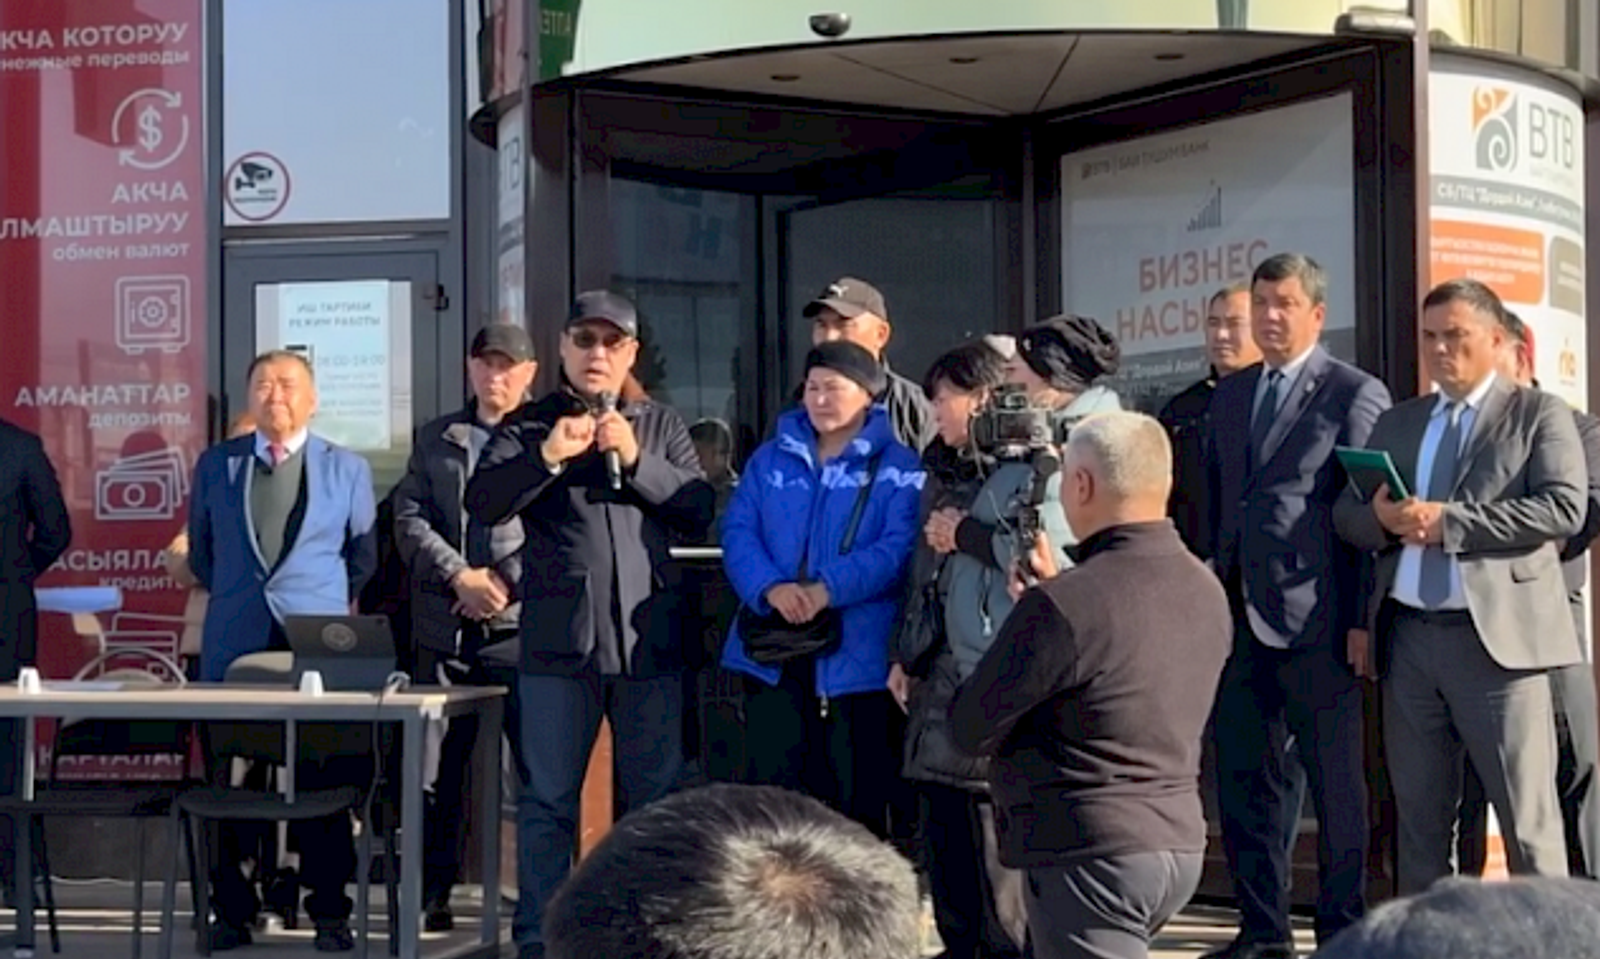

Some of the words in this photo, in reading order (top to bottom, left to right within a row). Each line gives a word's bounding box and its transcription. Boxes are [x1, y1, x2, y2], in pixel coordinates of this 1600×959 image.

[0, 29, 54, 50] КЧА
[63, 23, 188, 47] КОТОРУУ
[88, 51, 189, 70] переводы
[111, 180, 188, 203] АКЧА
[0, 212, 188, 239] ЛМАШТЫРУУ
[53, 244, 119, 261] обмен
[126, 243, 189, 260] валют
[1139, 240, 1268, 293] БИЗНЕС
[289, 317, 331, 328] РЕЖИМ
[335, 315, 381, 327] РАБОТЫ
[15, 383, 190, 407] АМАНАТТАР
[88, 412, 191, 429] депозиты
